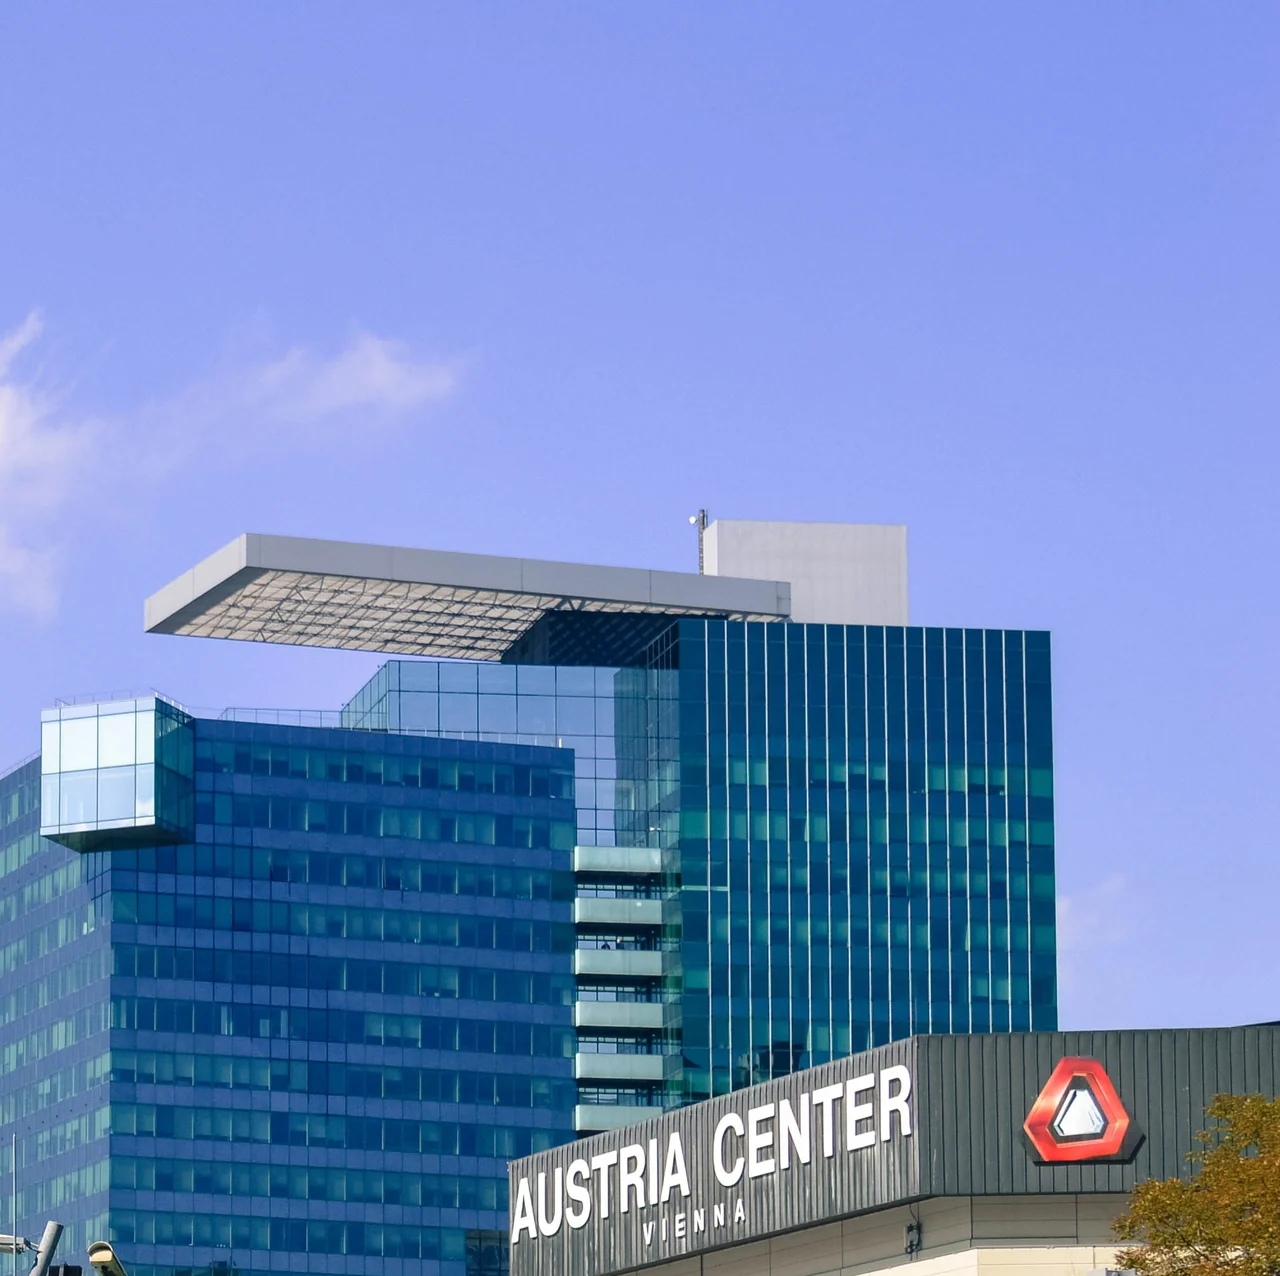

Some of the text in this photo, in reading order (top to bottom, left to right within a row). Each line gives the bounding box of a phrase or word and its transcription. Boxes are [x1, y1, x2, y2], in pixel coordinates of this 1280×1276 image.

[510, 1064, 912, 1244] AUSTRIA CENTER
[642, 1198, 746, 1245] VIENNA
